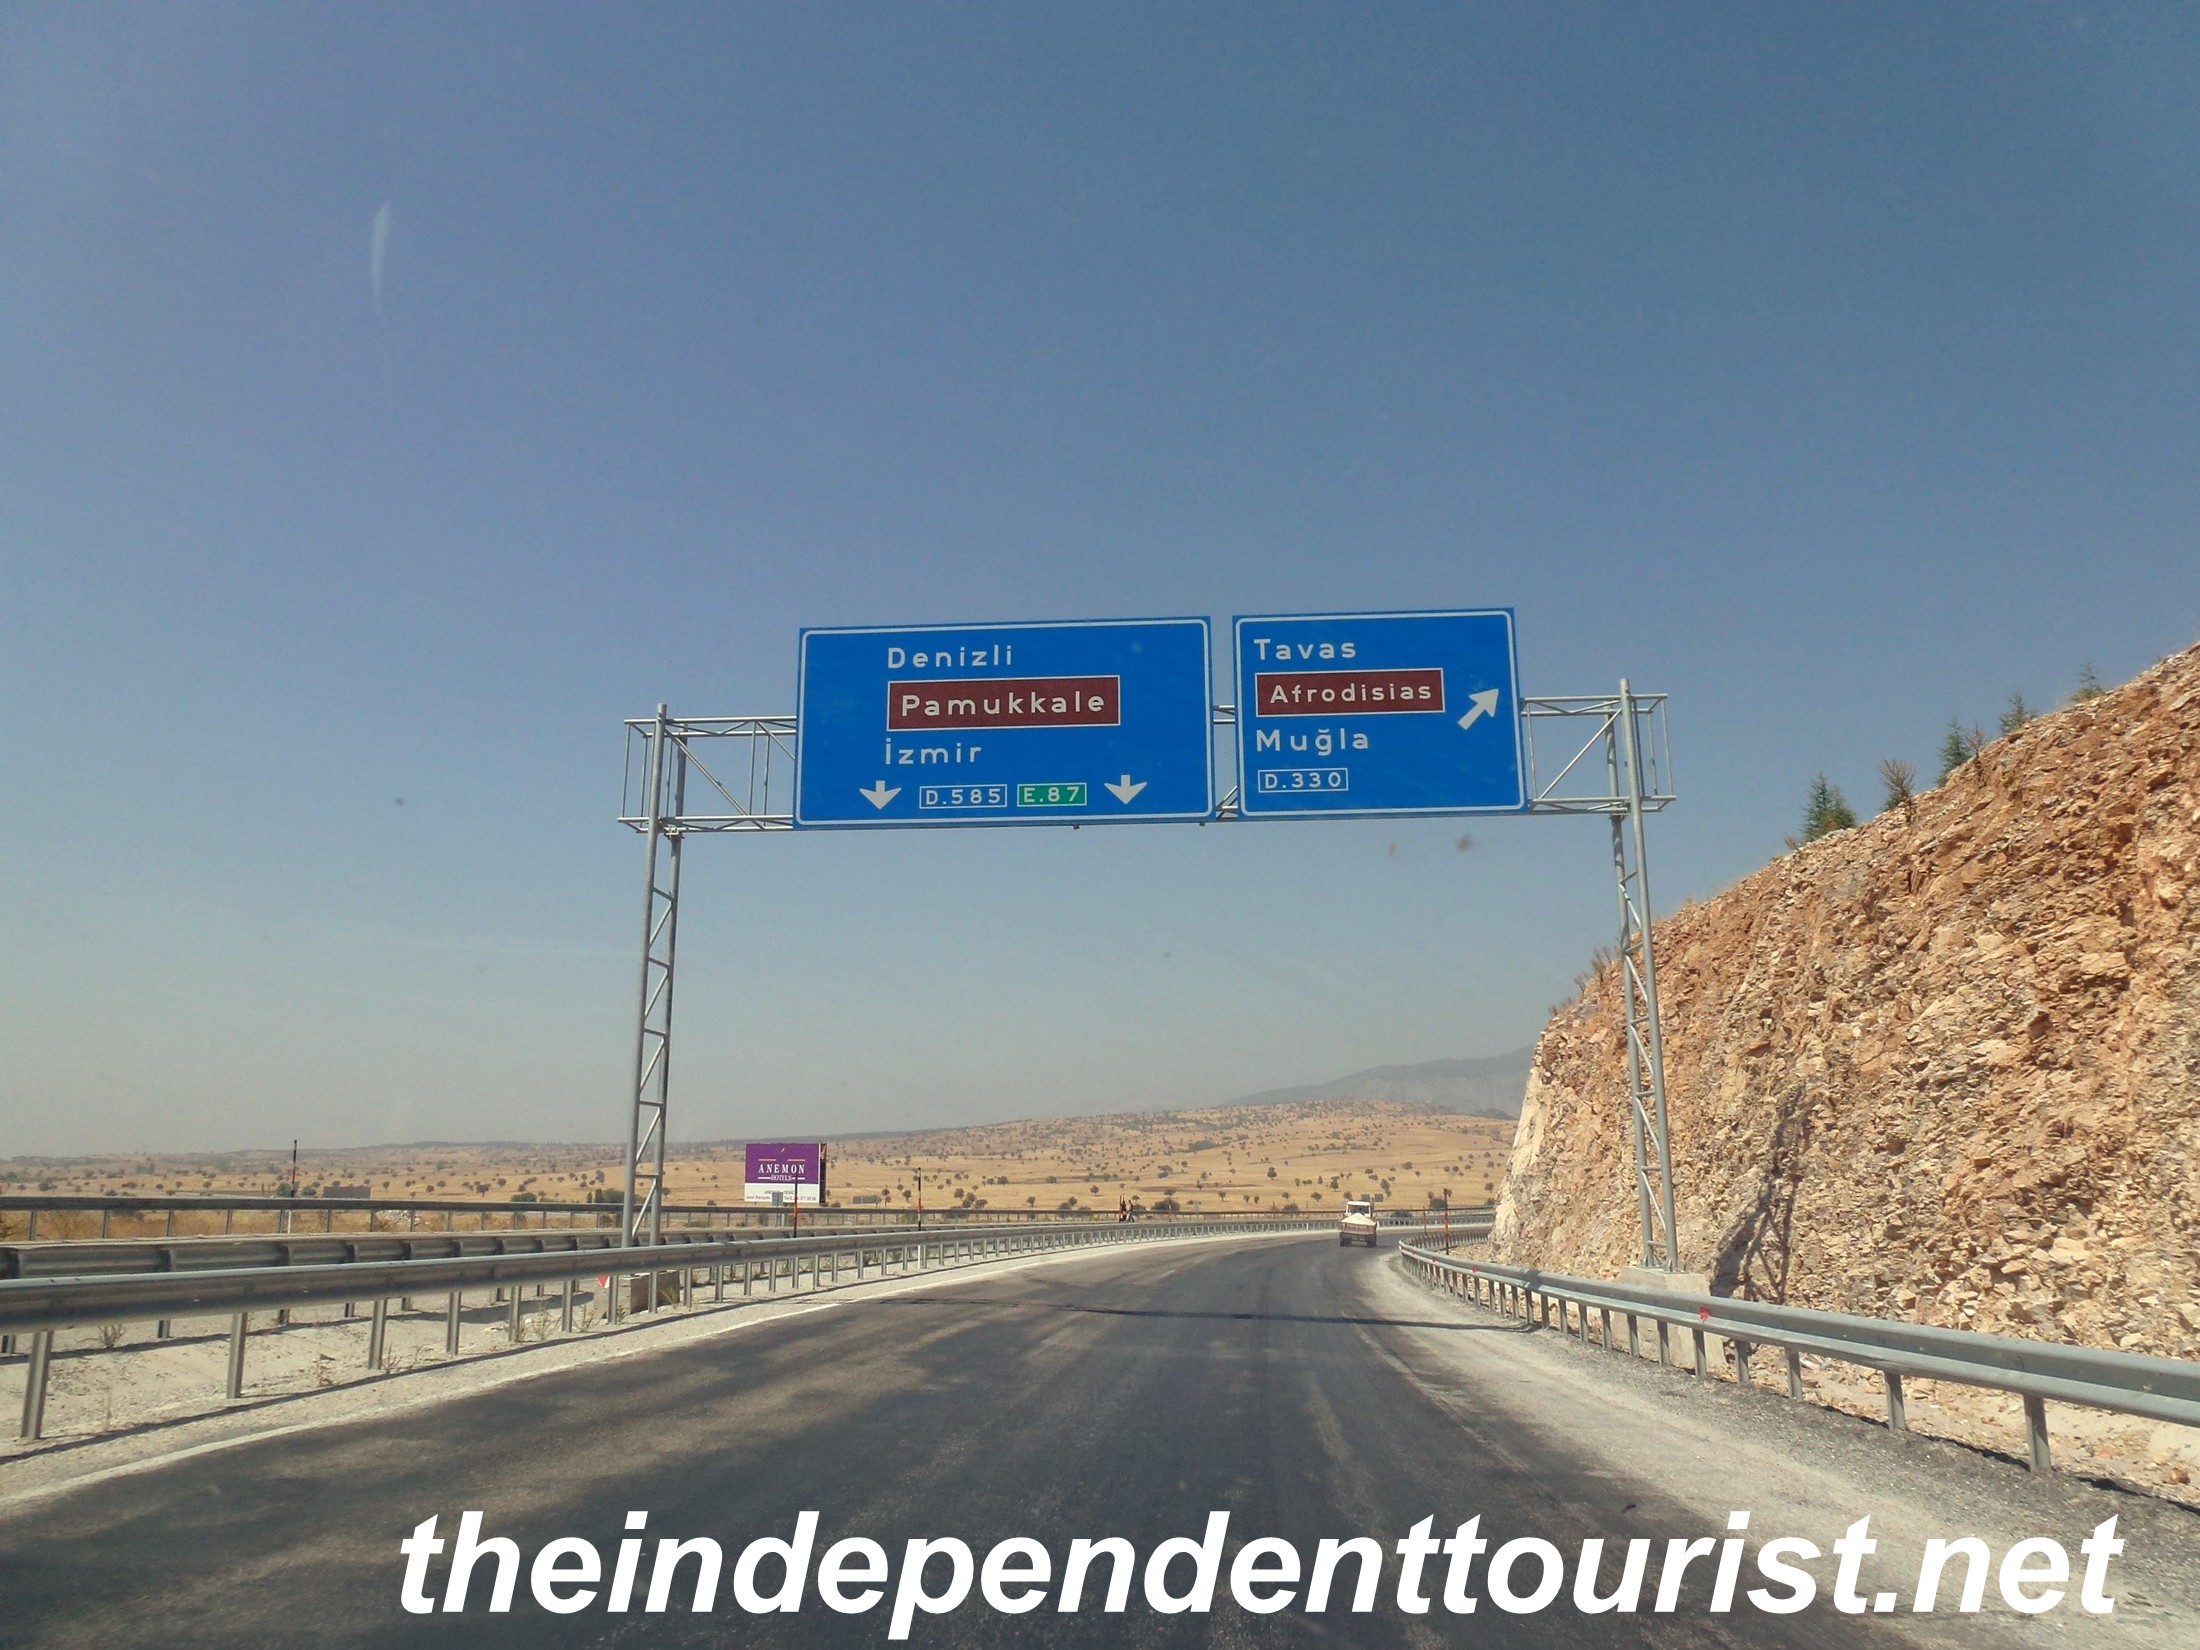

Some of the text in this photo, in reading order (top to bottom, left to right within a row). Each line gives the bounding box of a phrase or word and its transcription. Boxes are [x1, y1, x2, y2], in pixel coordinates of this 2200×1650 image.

[887, 645, 1013, 669] Denizli
[1254, 638, 1356, 660] Tavas
[901, 691, 1105, 717] Pamukkale
[1269, 683, 1432, 704] Afrodisias
[885, 738, 982, 765] İzmir
[1256, 728, 1369, 756] Muğla
[1264, 771, 1342, 789] D.330
[925, 788, 1001, 805] D.585
[1023, 786, 1080, 803] E.87
[758, 1163, 805, 1174] ANEMON
